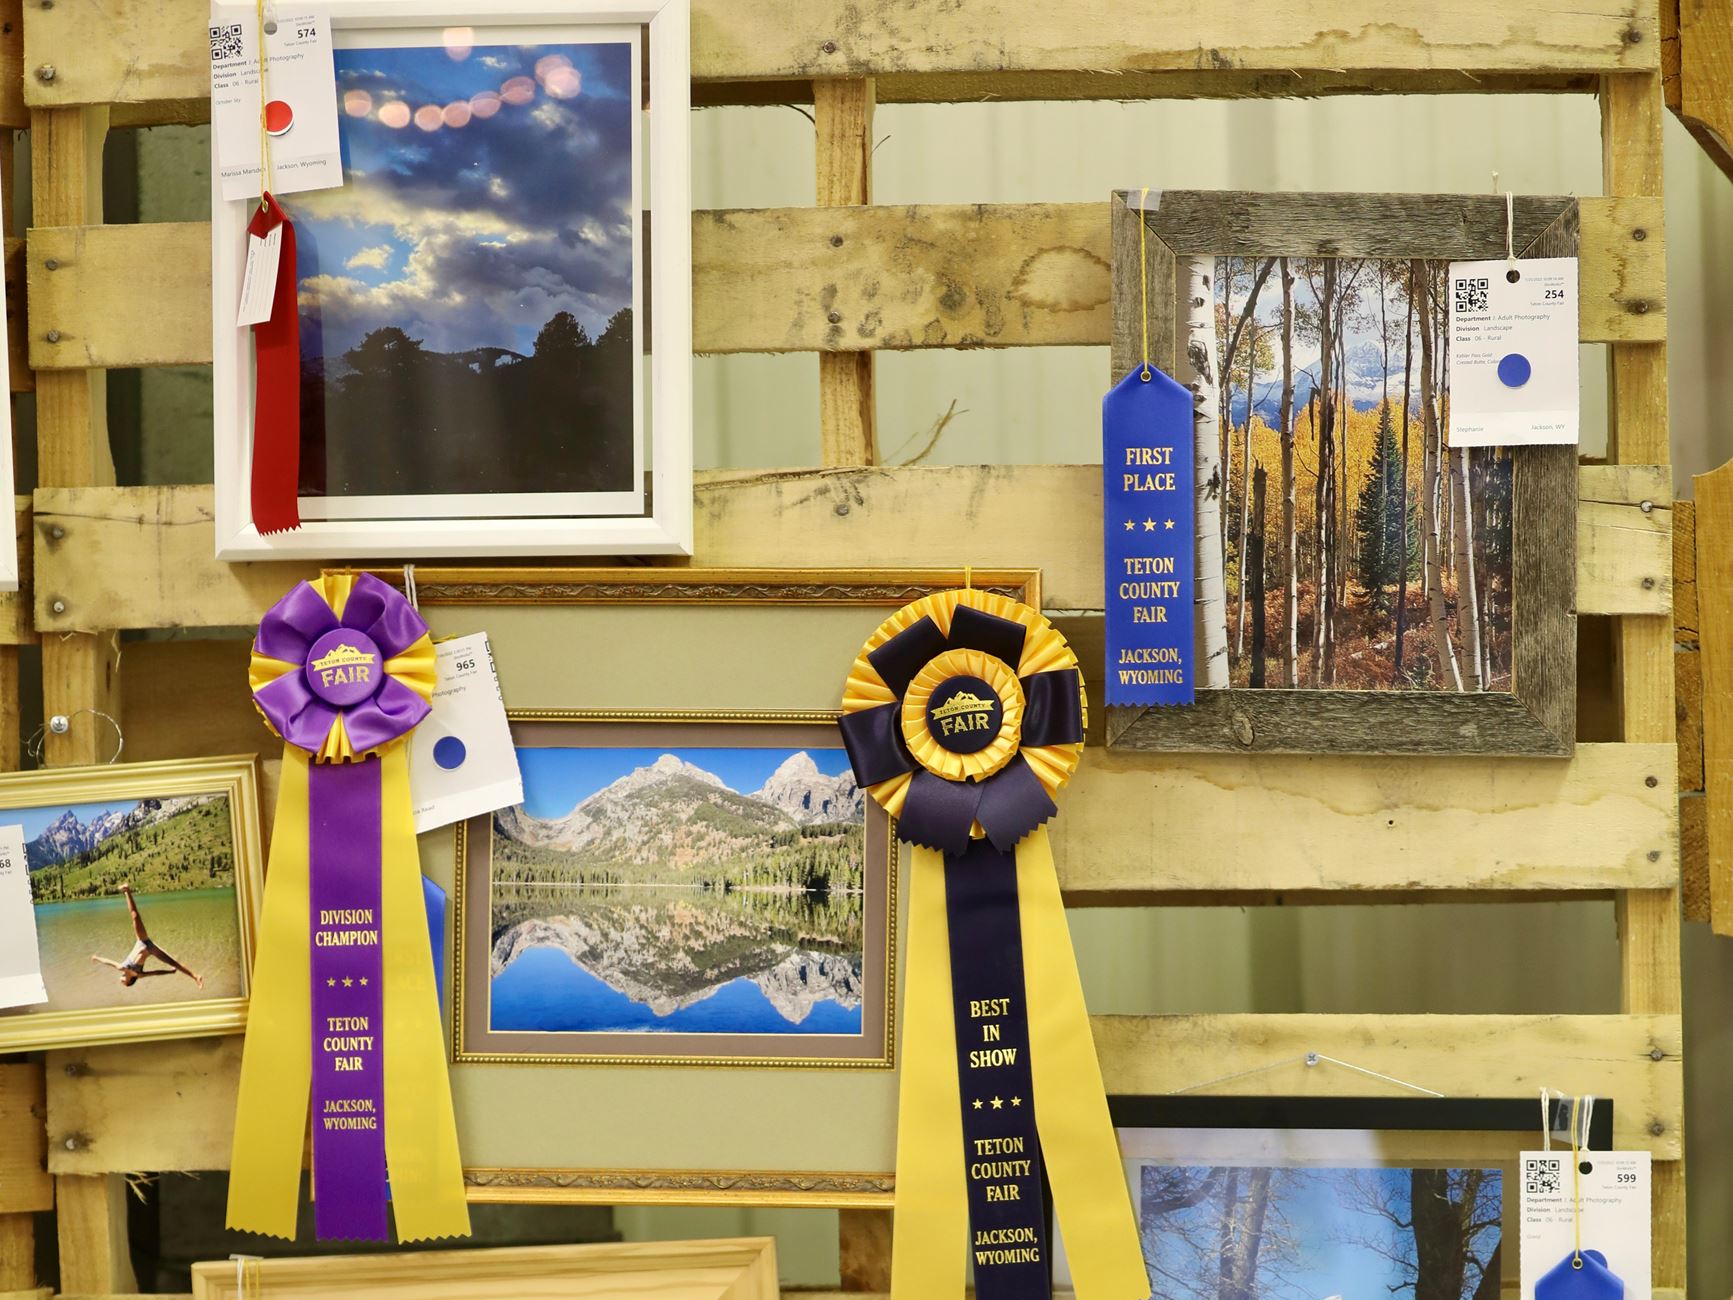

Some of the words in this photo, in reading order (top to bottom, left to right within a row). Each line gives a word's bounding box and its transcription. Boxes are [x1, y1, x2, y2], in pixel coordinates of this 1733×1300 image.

[297, 28, 316, 39] 574
[212, 61, 247, 71] Department
[269, 53, 304, 62] Photography
[241, 68, 268, 76] Landscpe
[300, 159, 326, 168] Wyoming
[221, 169, 241, 178] Marissa
[1545, 290, 1564, 299] 254
[1126, 447, 1173, 465] FIRST
[1123, 473, 1175, 492] PLACE
[1124, 557, 1174, 575] TETON
[1119, 581, 1180, 600] COUNTY
[1133, 606, 1167, 623] FAIR
[1118, 648, 1182, 664] JACKSON,
[456, 658, 476, 671] 965
[321, 665, 369, 688] FAIR
[1118, 669, 1183, 685] WYOMING
[940, 707, 958, 715] TETON
[941, 713, 990, 736] FAIR
[320, 909, 373, 925] DIVISION
[315, 930, 378, 946] CHAMPION
[970, 998, 1010, 1018] BEST
[327, 1017, 368, 1032] TETON
[983, 1025, 1000, 1042] IN
[323, 1037, 373, 1052] COUNTY
[335, 1057, 363, 1071] FAIR
[970, 1048, 1017, 1068] SHOW
[323, 1099, 376, 1113] JACKSON,
[323, 1117, 376, 1130] WYOMING
[974, 1137, 1024, 1156] TETON
[971, 1160, 1031, 1180] COUNTY
[1617, 1174, 1636, 1183] 599
[986, 1184, 1020, 1201] FAIR
[975, 1227, 1038, 1246] JACKSON,
[976, 1248, 1040, 1266] WYOMING
